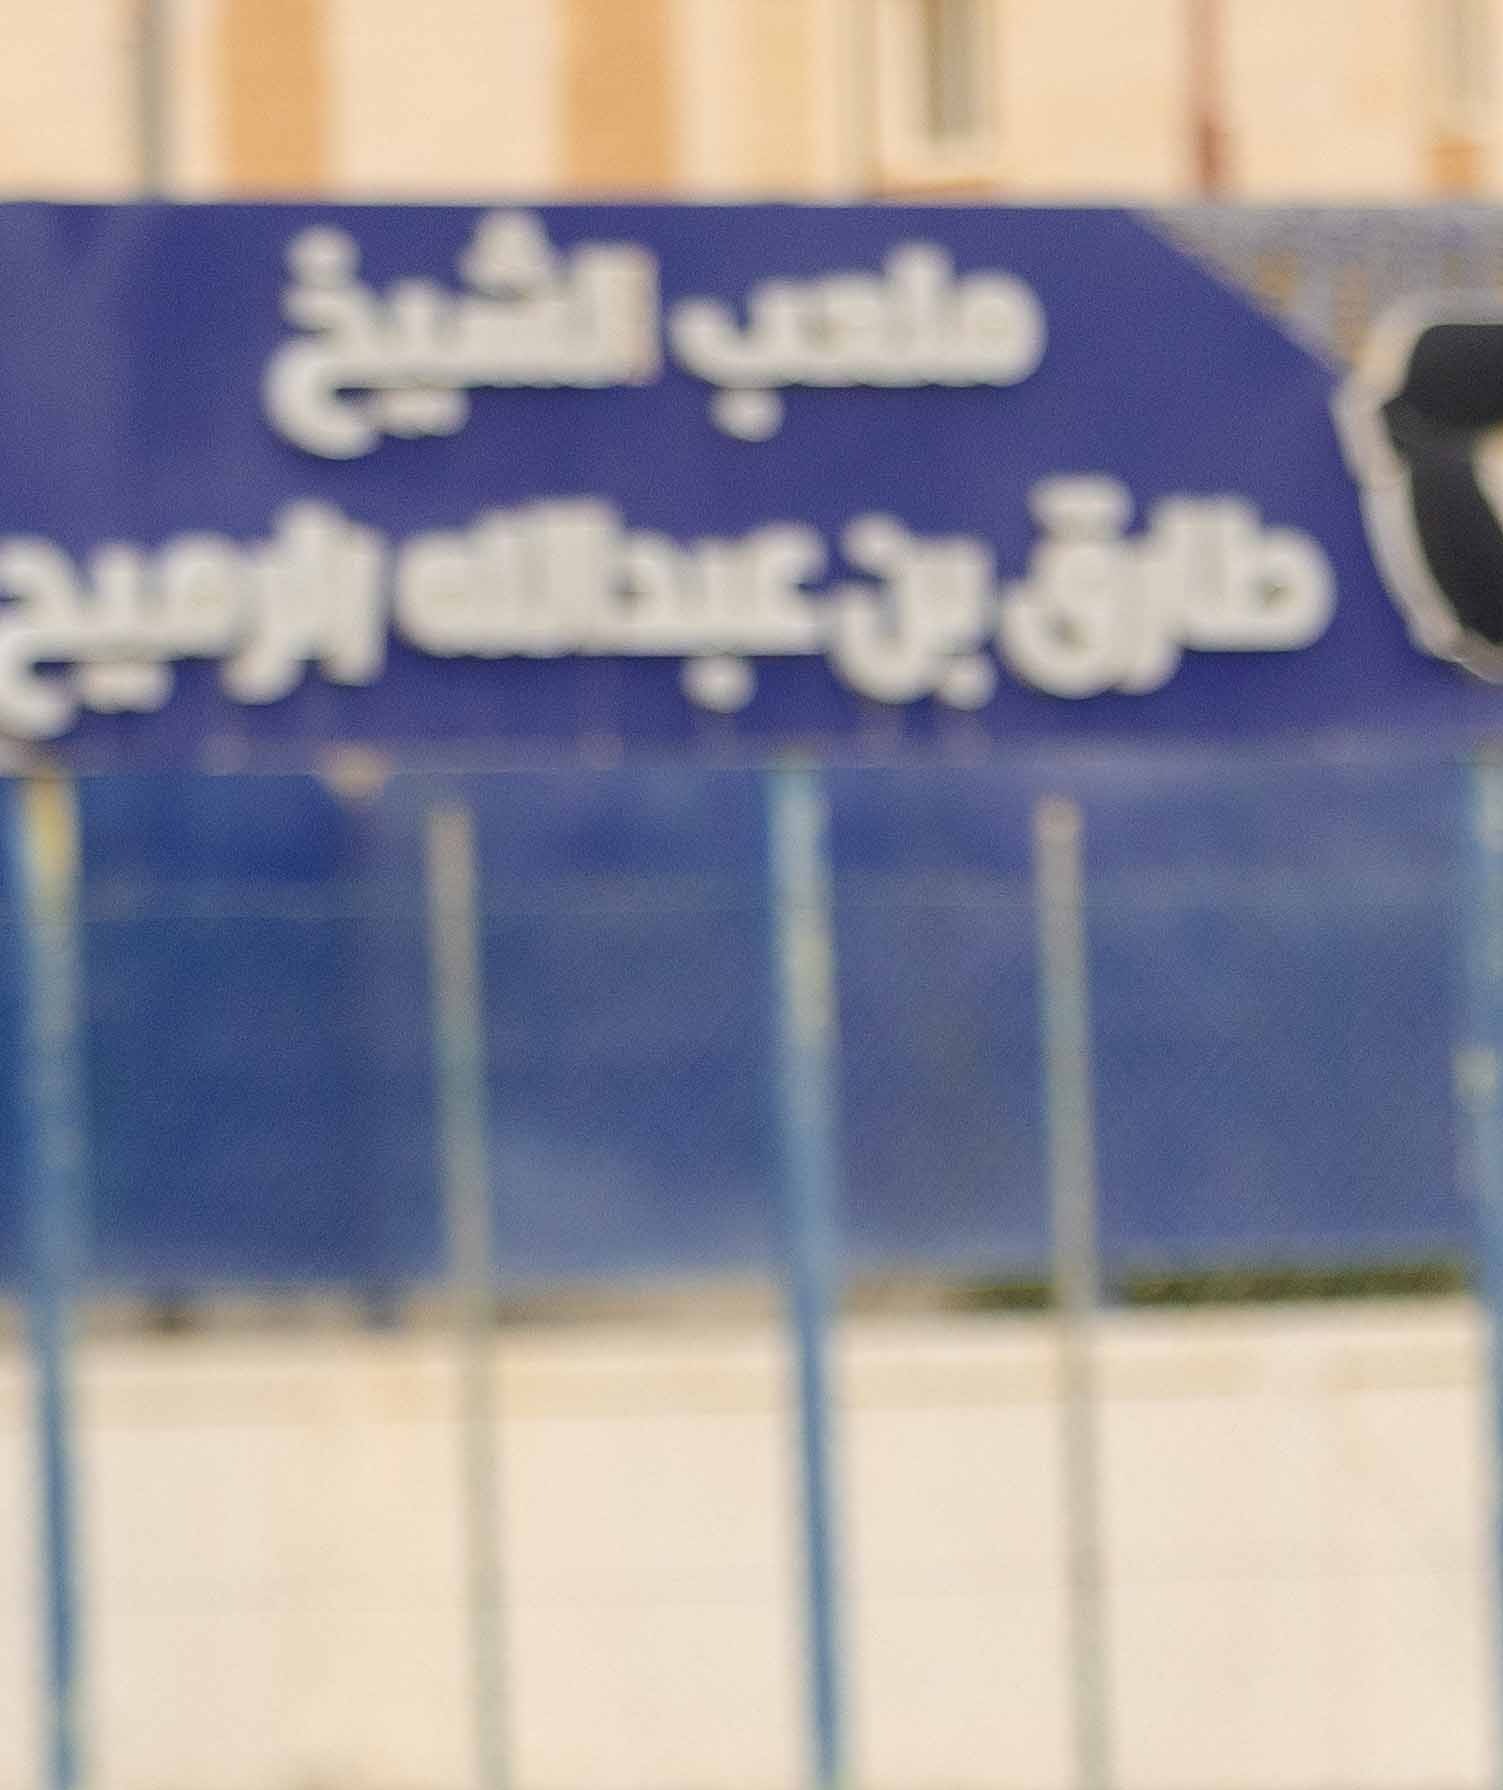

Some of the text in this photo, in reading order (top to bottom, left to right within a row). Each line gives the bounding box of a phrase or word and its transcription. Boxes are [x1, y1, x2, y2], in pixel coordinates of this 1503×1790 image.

[266, 213, 1044, 457] ملعب الشيخ
[832, 517, 995, 710] بن
[1000, 478, 1332, 698] طارق
